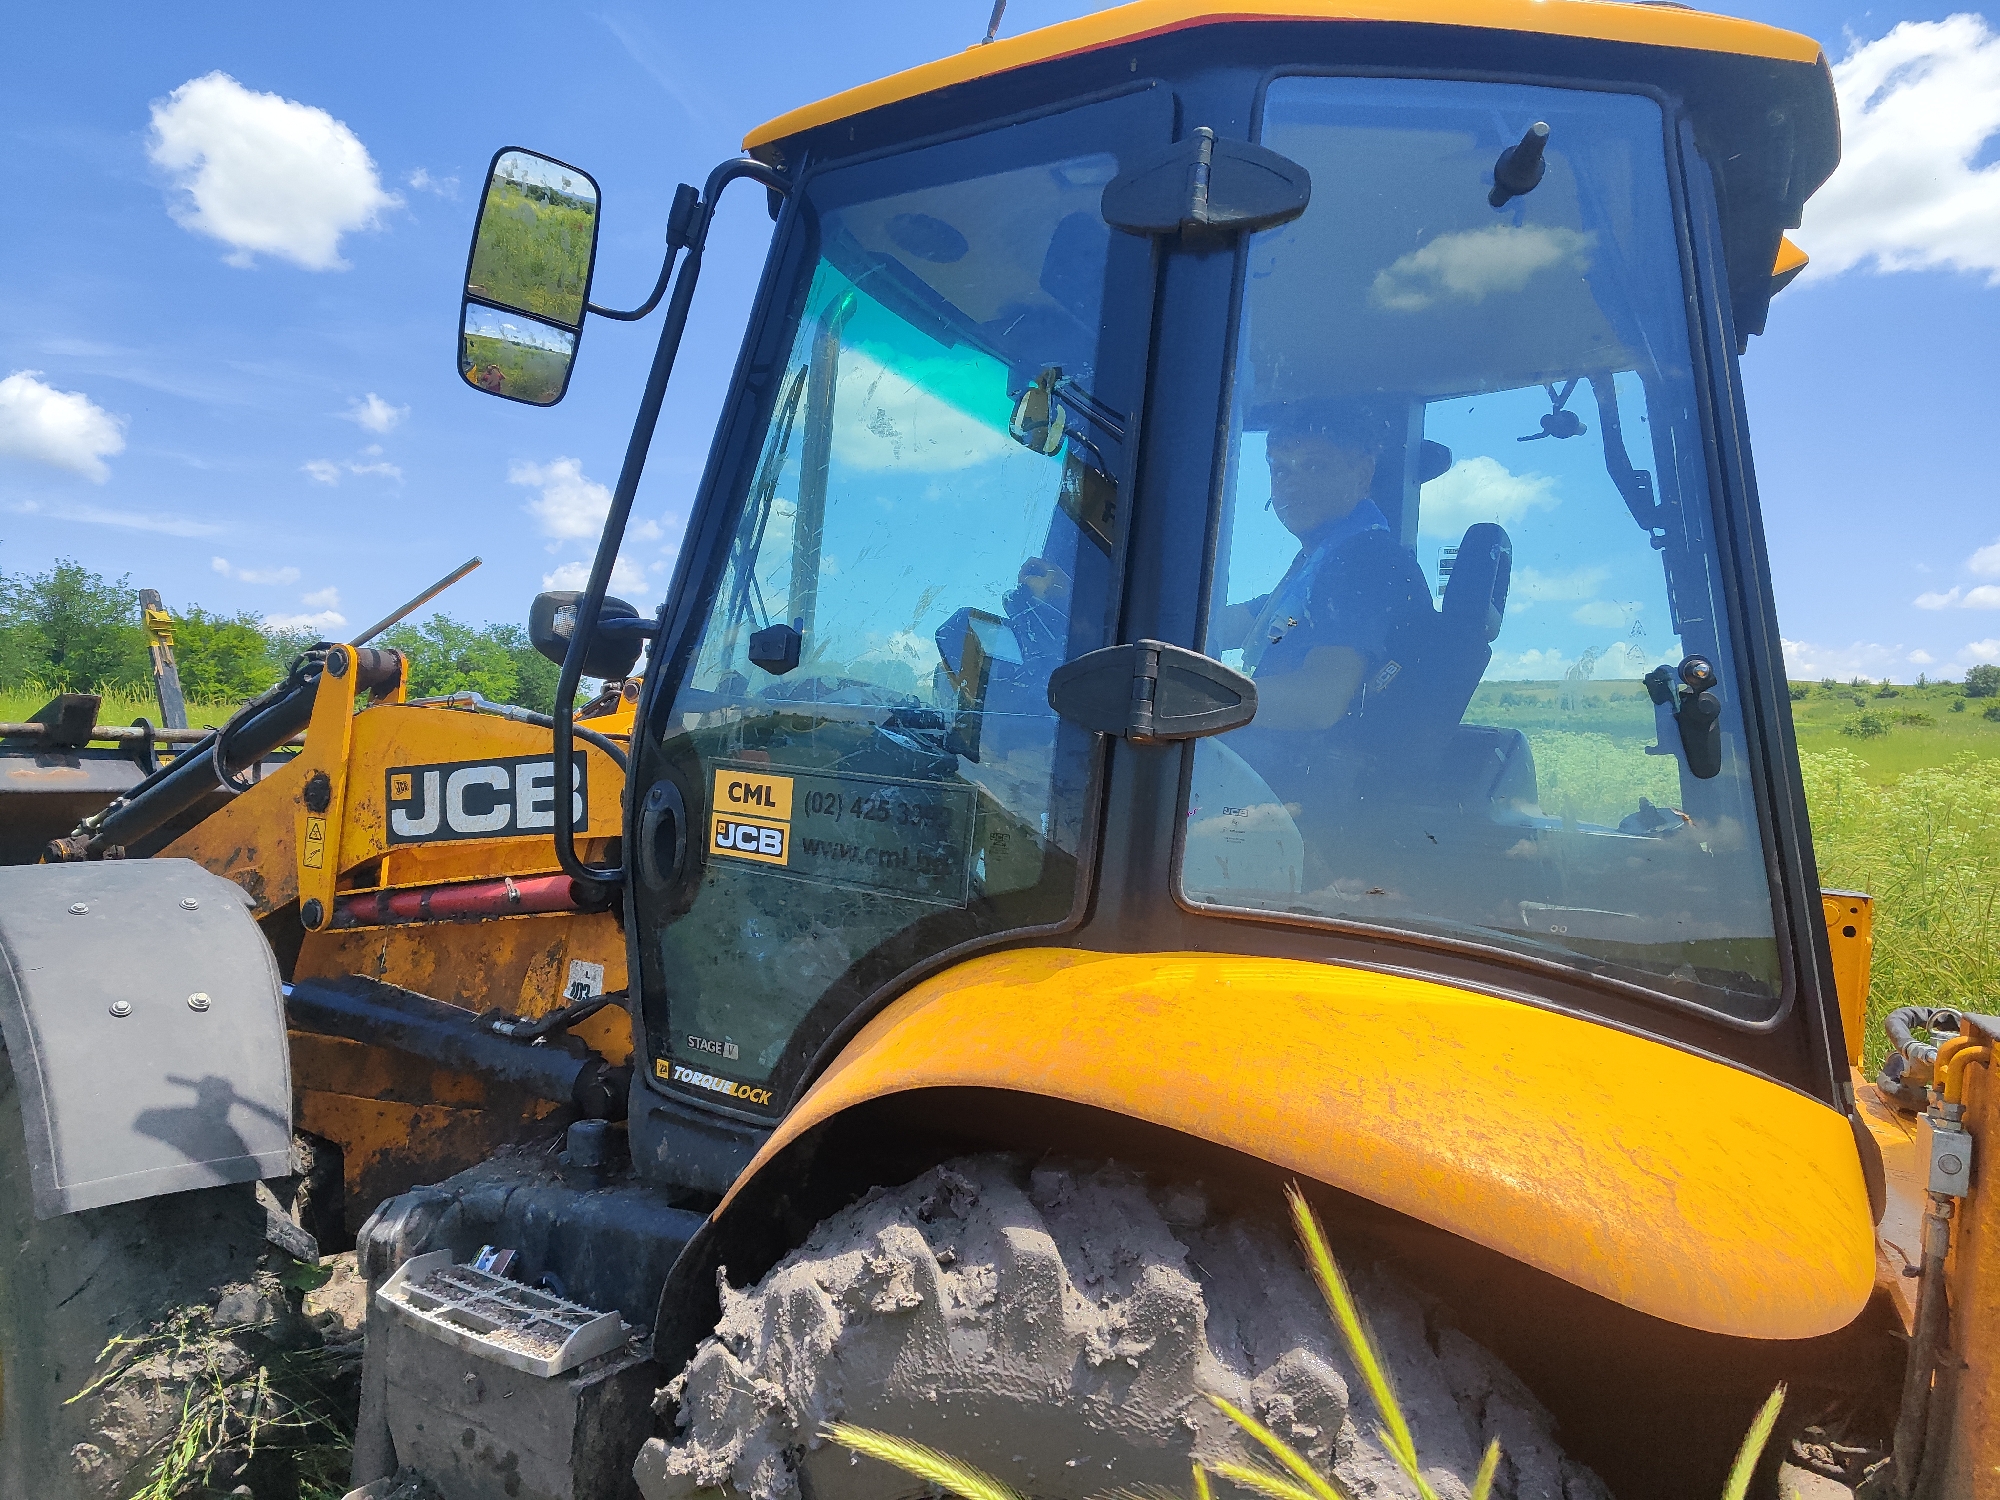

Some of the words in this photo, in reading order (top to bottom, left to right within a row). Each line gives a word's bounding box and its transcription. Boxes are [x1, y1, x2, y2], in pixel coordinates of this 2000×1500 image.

[391, 761, 583, 837] JCB
[728, 782, 776, 808] CML
[804, 790, 843, 823] (02)
[850, 796, 891, 823] 425
[897, 801, 952, 833] 33
[717, 823, 782, 855] JCB
[802, 838, 952, 876] www.cml.b
[687, 1035, 722, 1055] STAGE
[673, 1065, 773, 1106] TORQUELOCK
